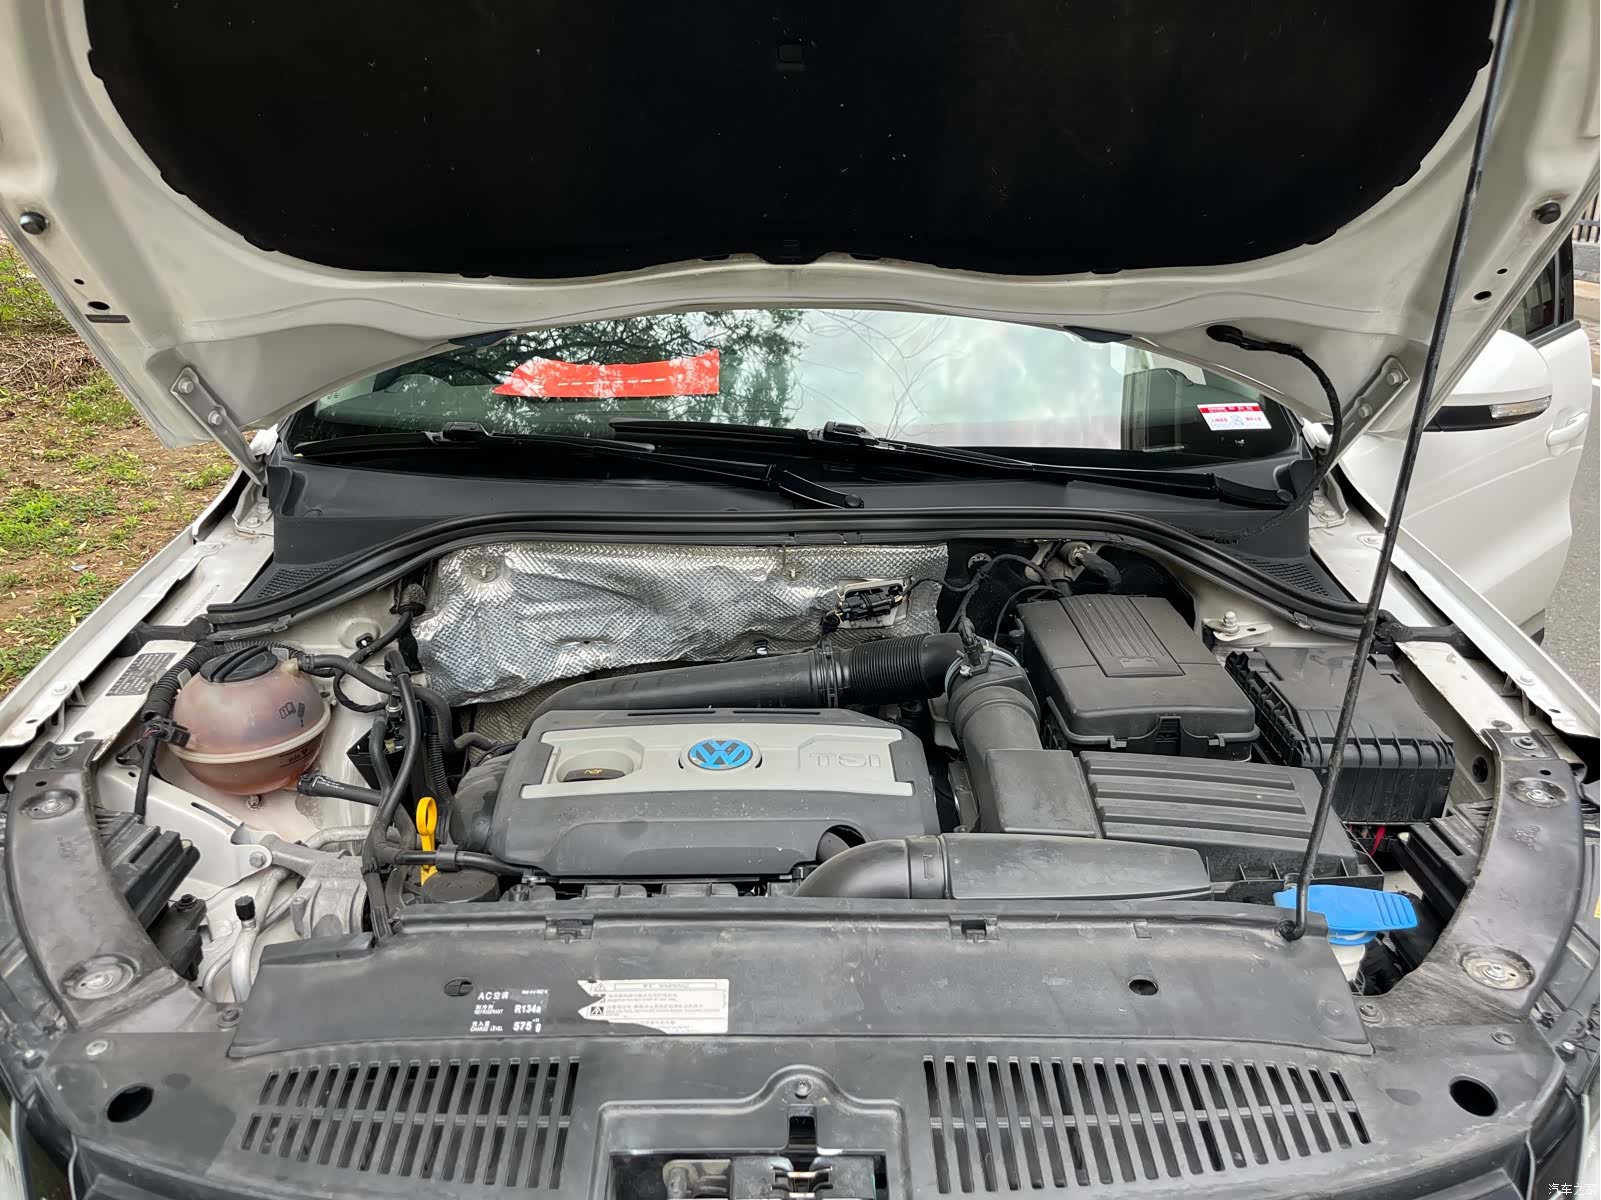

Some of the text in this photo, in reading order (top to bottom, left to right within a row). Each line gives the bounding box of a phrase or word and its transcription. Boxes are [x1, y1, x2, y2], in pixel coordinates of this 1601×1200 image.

[808, 751, 882, 769] TSI
[514, 1004, 542, 1013] R134a
[513, 1021, 532, 1031] 575
